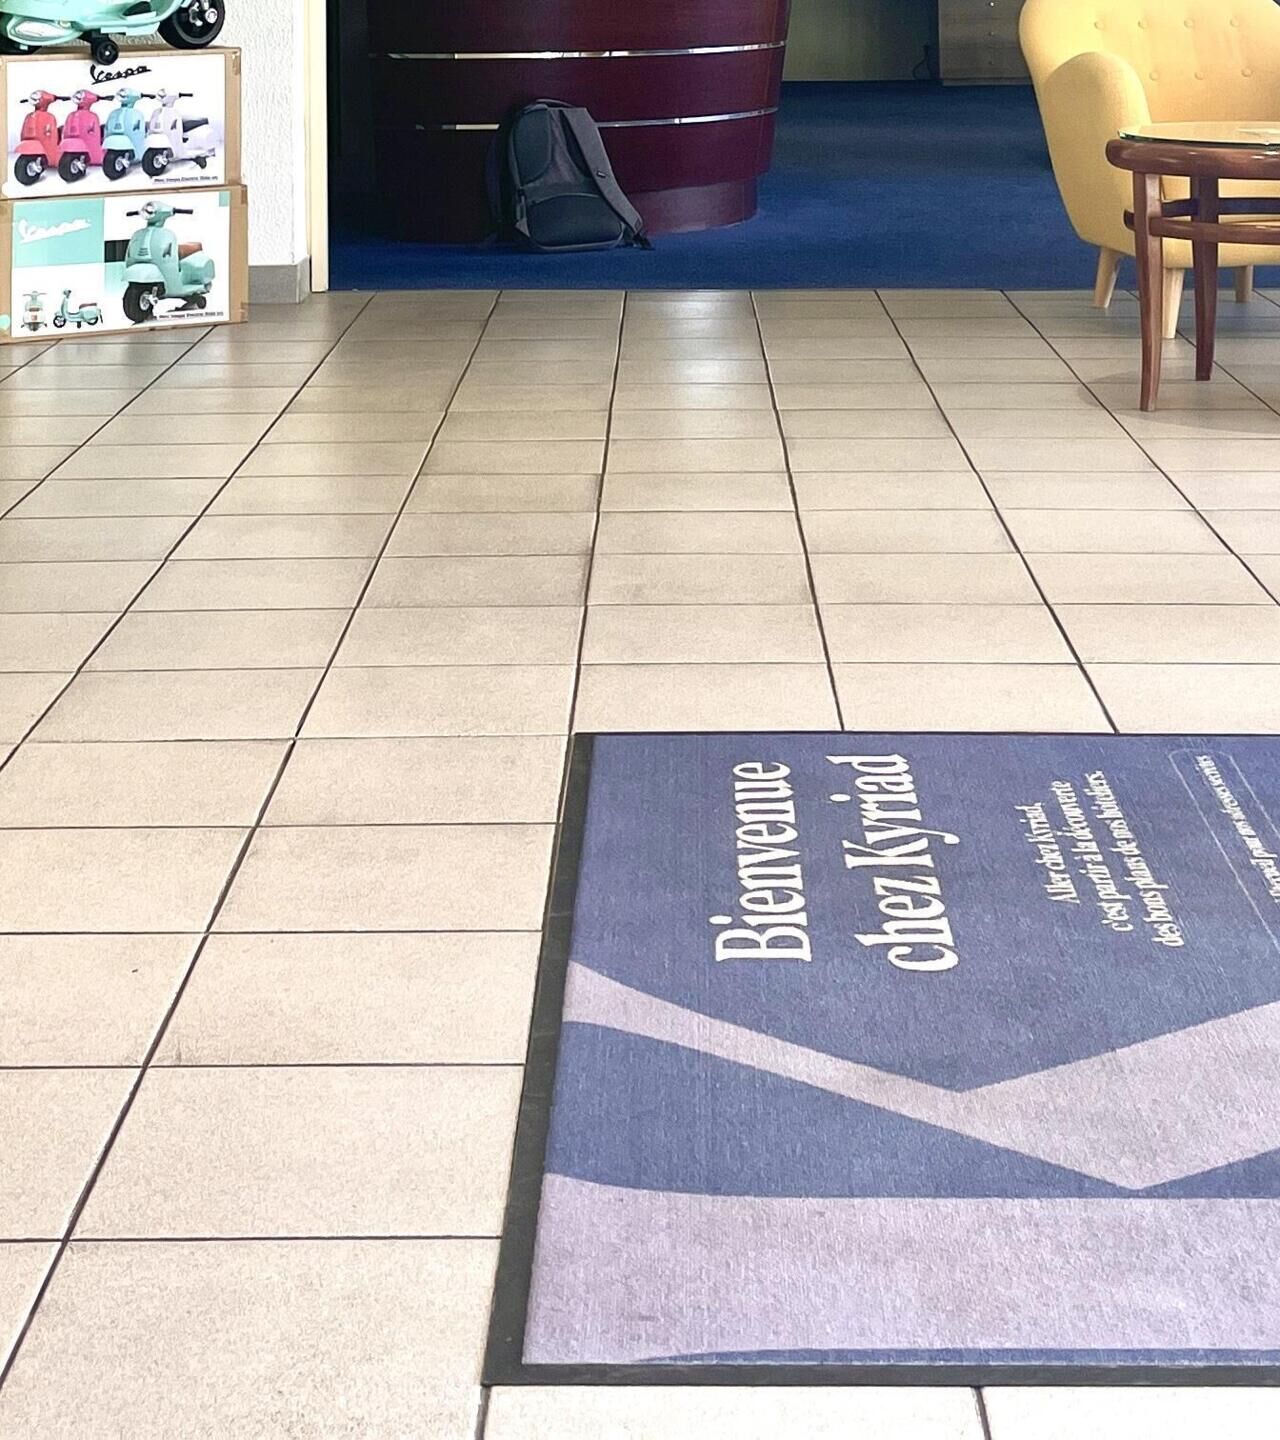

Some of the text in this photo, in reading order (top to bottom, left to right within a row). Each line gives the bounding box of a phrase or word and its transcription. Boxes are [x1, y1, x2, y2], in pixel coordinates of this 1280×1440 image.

[90, 63, 152, 85] Vespa
[1104, 819, 1135, 840] nos
[708, 761, 812, 962] Bienvenue
[825, 753, 960, 972] chez Kyriad
[1014, 801, 1081, 904] Aller chez Kyriad,
[1050, 780, 1134, 932] c'est partir à la découverte
[1108, 840, 1142, 856] de
[1242, 836, 1279, 858] pour
[1123, 856, 1170, 890] plans
[1139, 890, 1174, 923] bons
[1151, 922, 1185, 948] des
